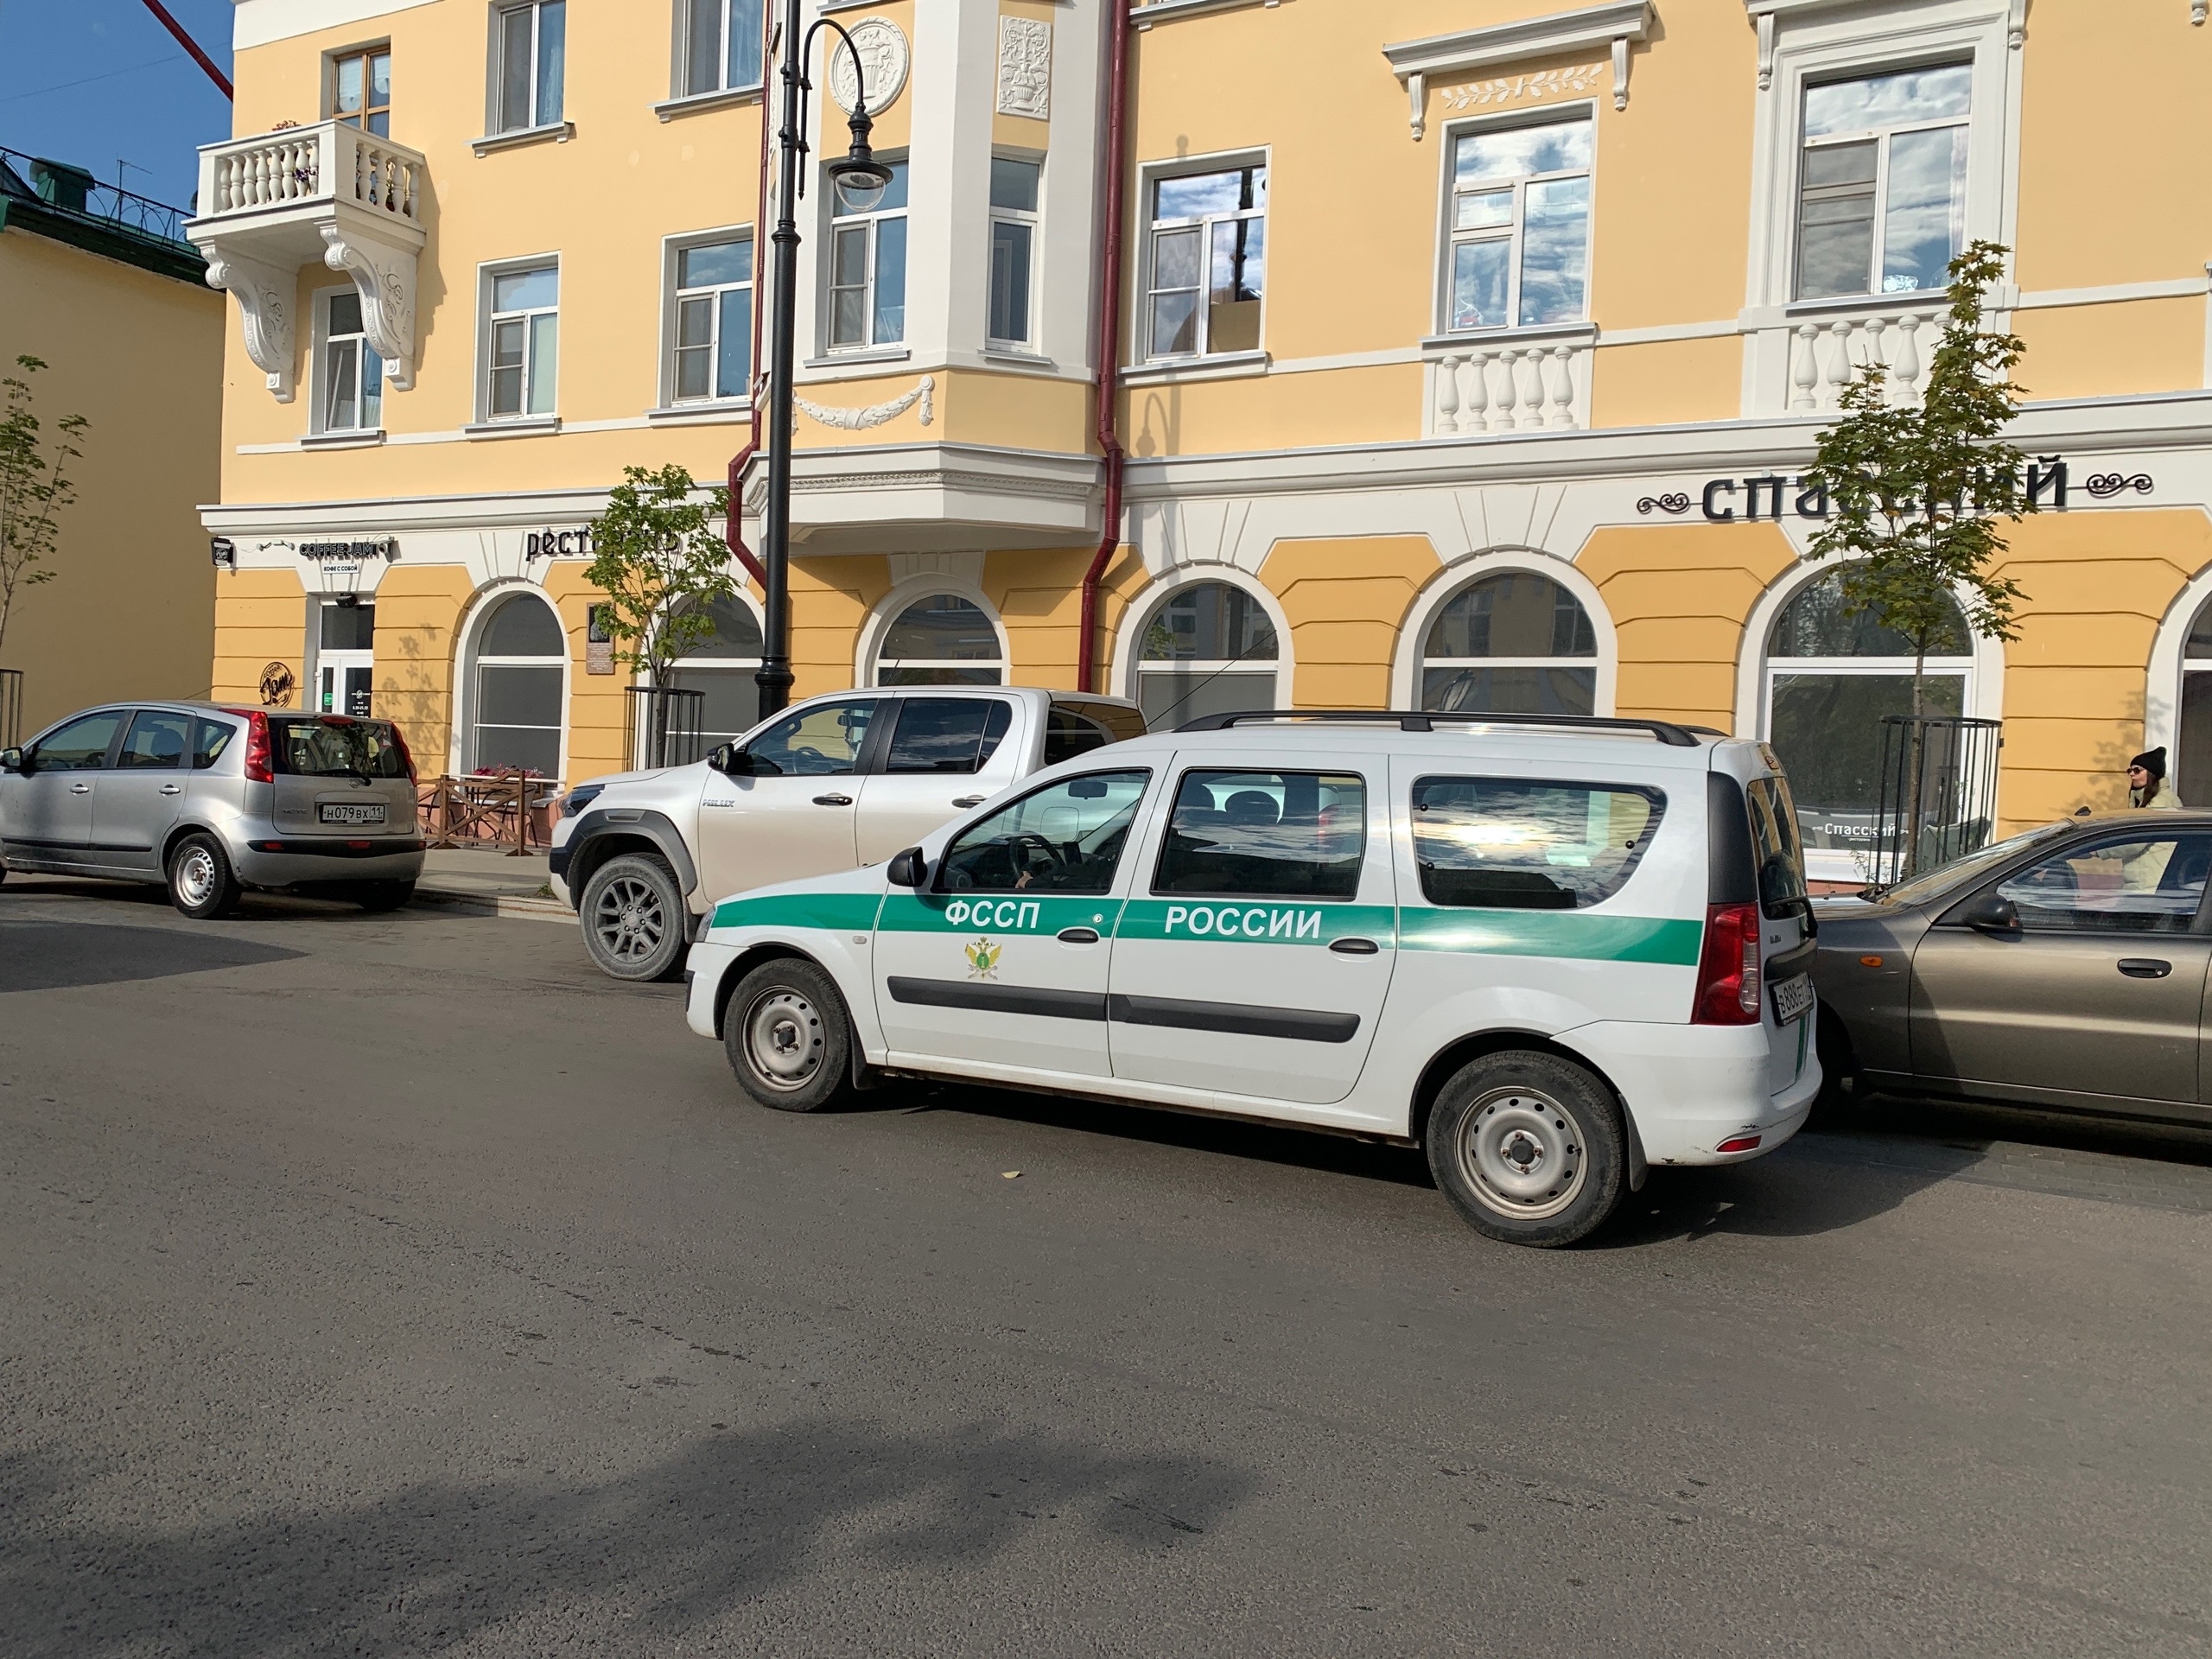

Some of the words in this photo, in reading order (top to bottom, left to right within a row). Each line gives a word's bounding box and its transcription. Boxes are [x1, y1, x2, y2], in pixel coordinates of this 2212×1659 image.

[299, 543, 346, 556] COFFEE
[347, 542, 375, 556] JAM
[702, 799, 735, 808] HILUX
[944, 899, 1041, 929] ФССП
[1164, 906, 1322, 939] РОССИИ
